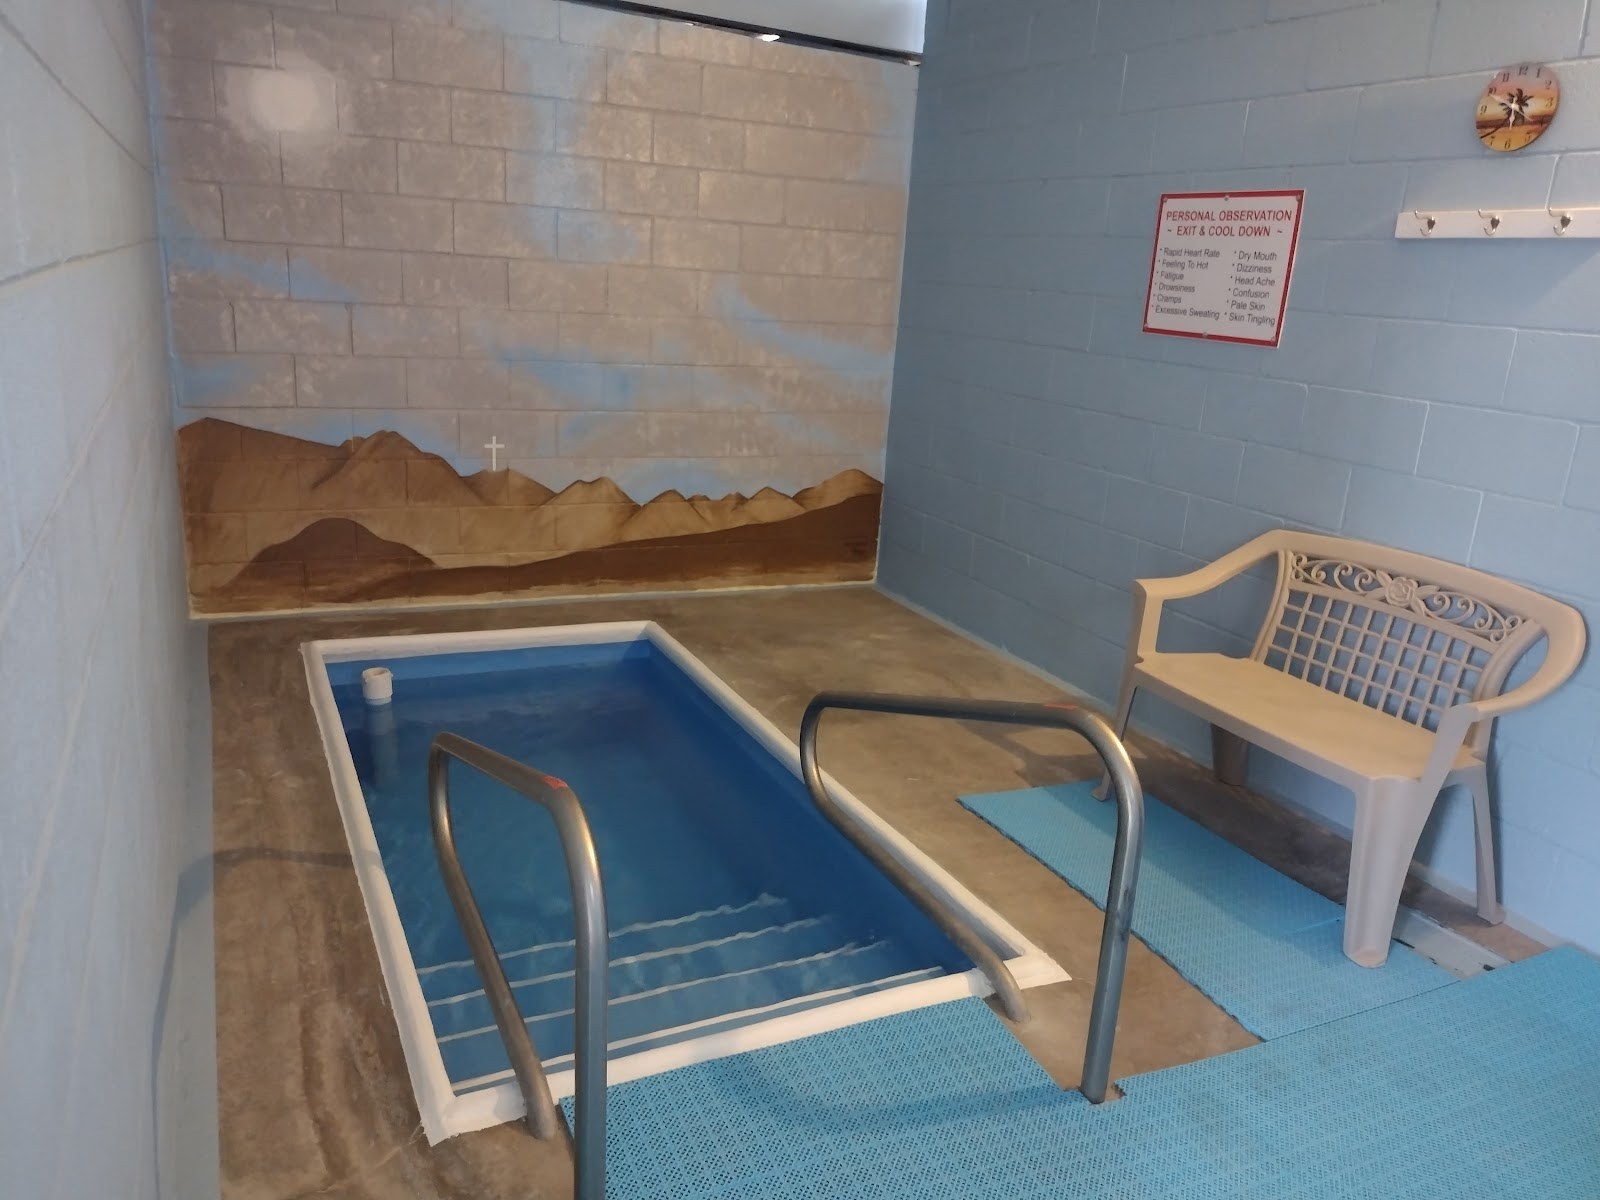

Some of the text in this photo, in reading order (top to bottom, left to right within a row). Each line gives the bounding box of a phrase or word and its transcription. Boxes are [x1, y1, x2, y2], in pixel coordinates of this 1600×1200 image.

[1518, 65, 1528, 76] 12
[1536, 68, 1541, 78] 1
[1502, 73, 1510, 82] 11
[1545, 80, 1552, 89] 2
[1488, 87, 1497, 96] 10
[1546, 98, 1553, 107] 3
[1480, 105, 1488, 115] 9
[1504, 139, 1511, 149] 6
[1166, 210, 1292, 221] PERSONAL OBSERVATION
[1177, 226, 1198, 236] EXIT
[1199, 226, 1205, 236] &
[1208, 226, 1235, 236] COOL
[1238, 226, 1270, 236] DOWN
[1164, 247, 1220, 258] Rapid Heart Rate
[1239, 251, 1277, 261] Dry Mouth
[1162, 259, 1209, 269] Feeling To Hot
[1237, 263, 1272, 273] Dizziness
[1161, 271, 1184, 281] Fatigue
[1235, 276, 1275, 286] Head Ache
[1159, 282, 1195, 292] Drowsiness
[1157, 294, 1182, 303] Cramps
[1233, 288, 1270, 299] Confusion
[1231, 300, 1266, 311] Pale Skin
[1156, 305, 1220, 320] Excessive Sweating
[1229, 312, 1275, 327] Skin Tingling
